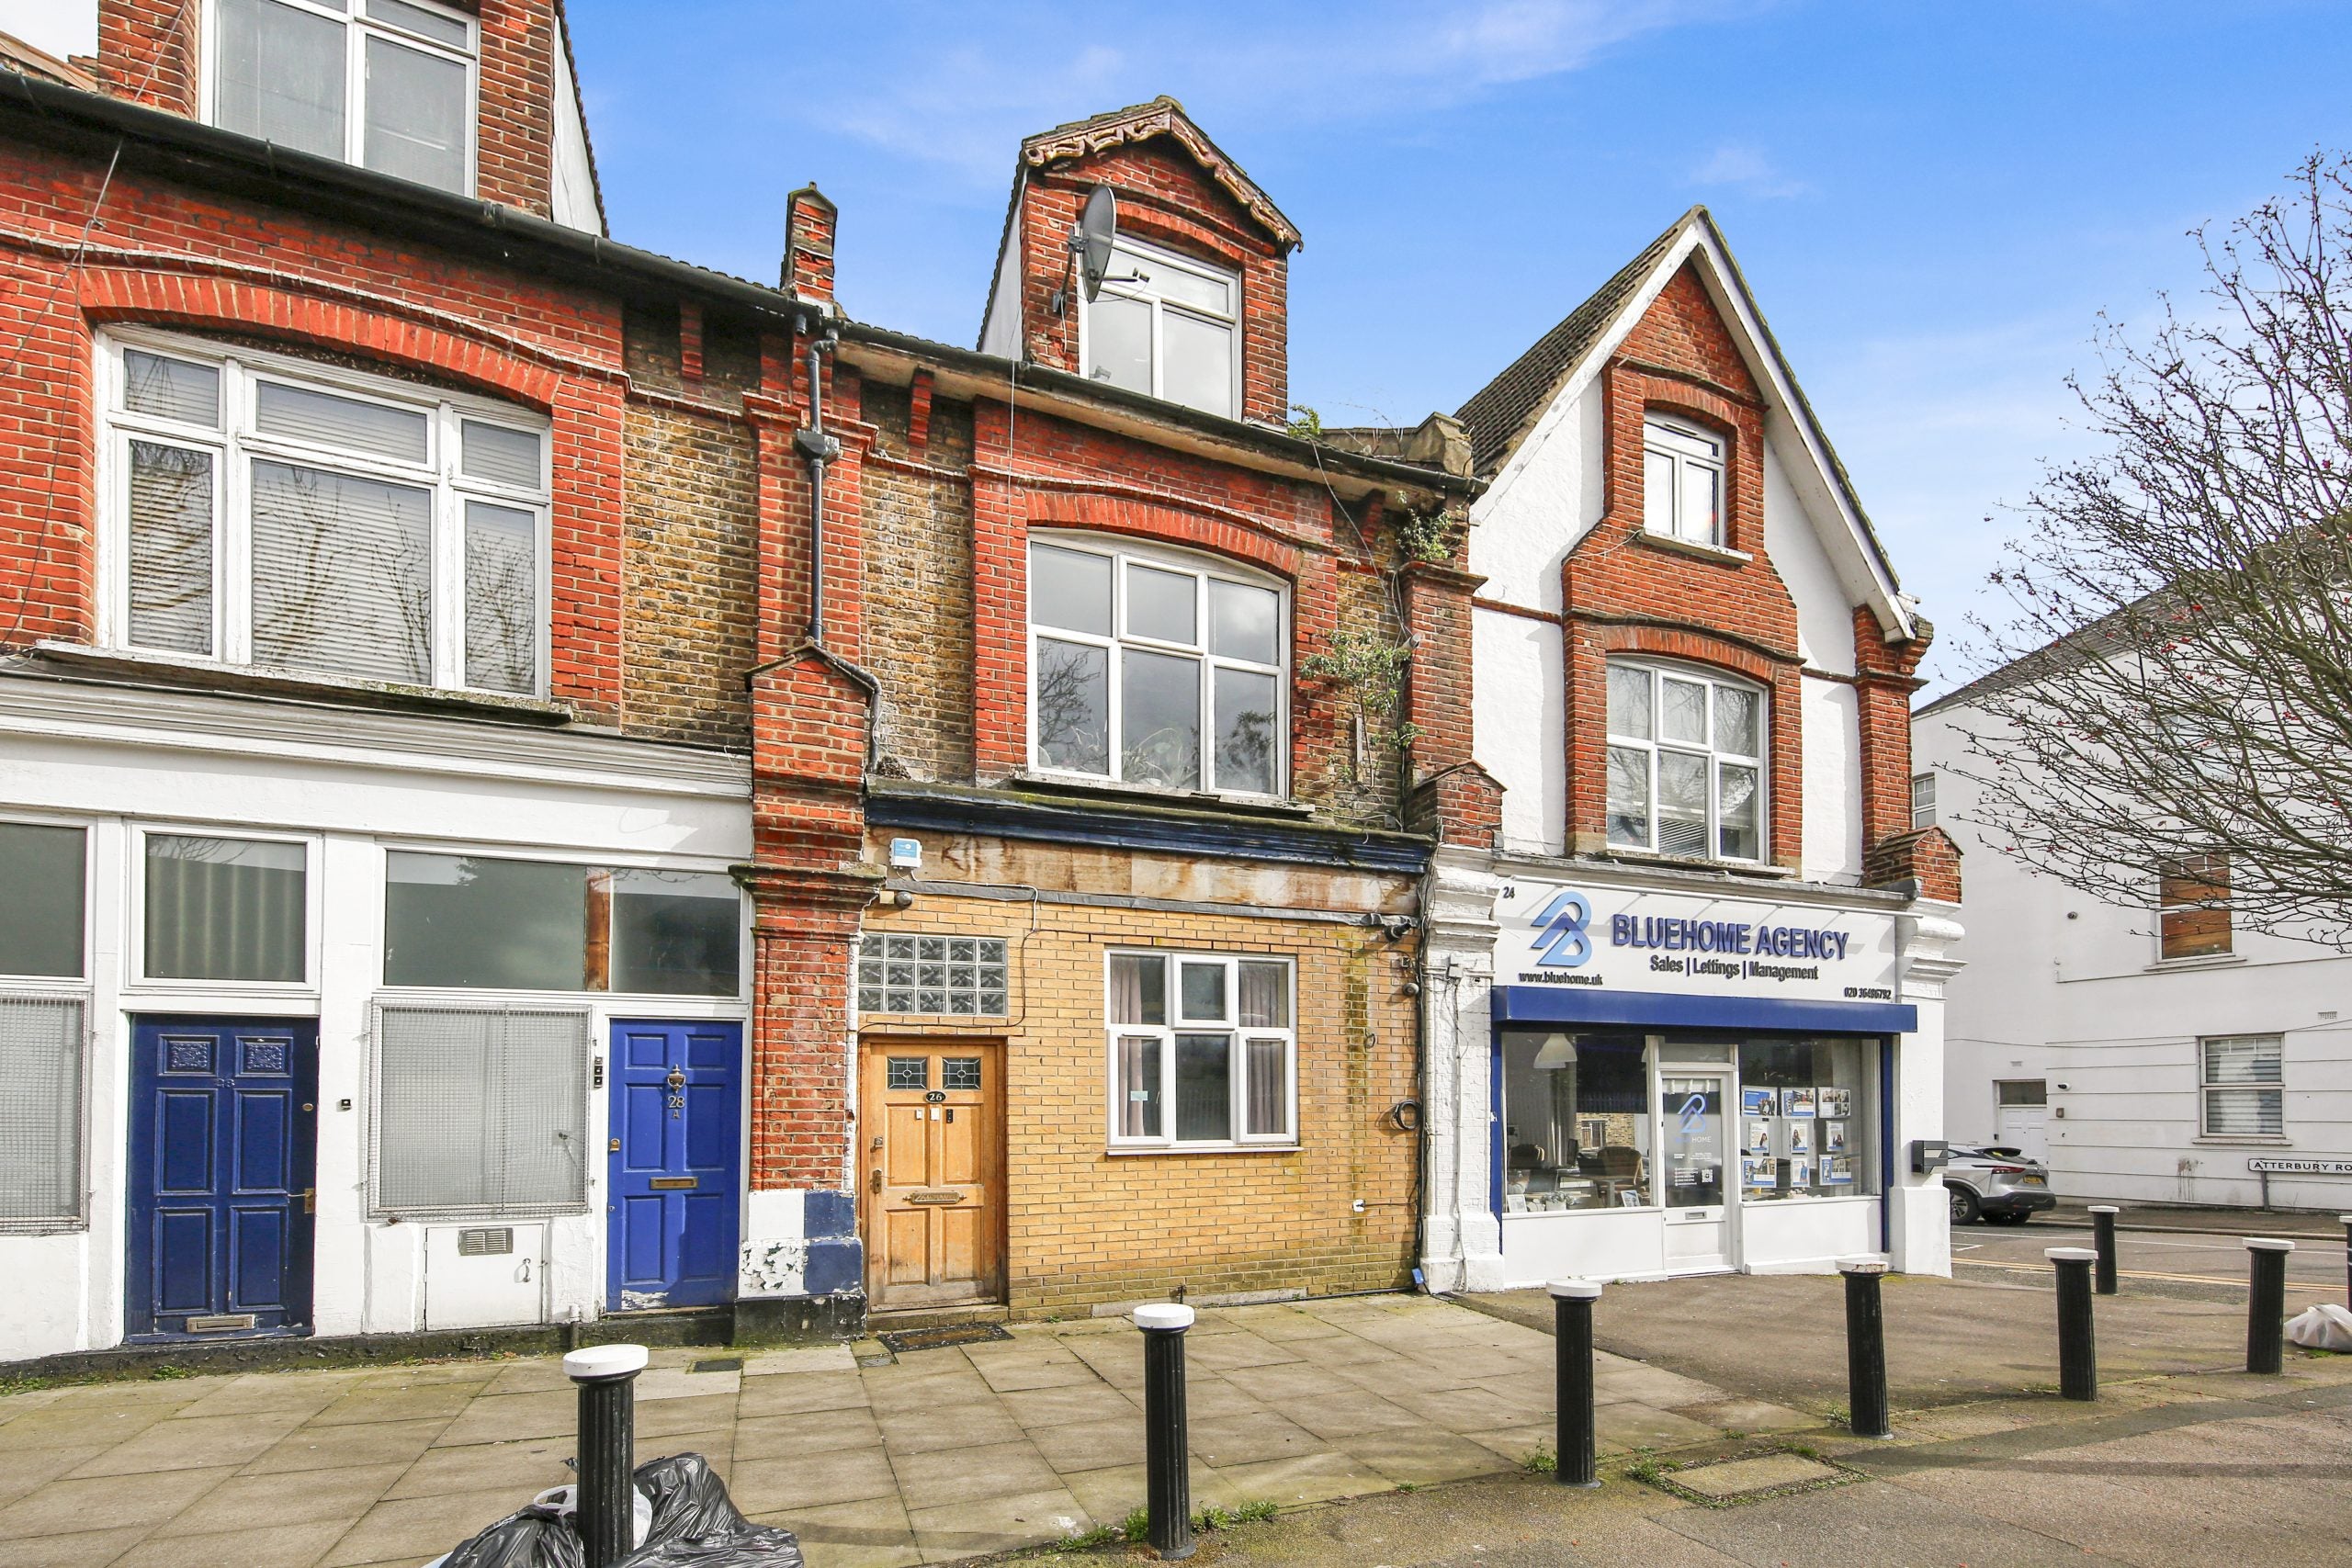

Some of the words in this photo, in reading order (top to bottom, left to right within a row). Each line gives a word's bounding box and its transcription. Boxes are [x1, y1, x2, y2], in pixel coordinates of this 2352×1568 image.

[1502, 886, 1515, 898] 24
[1612, 913, 1751, 954] BLUEHOME
[1756, 925, 1849, 960] AGENCY
[1650, 954, 1683, 973] Sales
[1692, 957, 1740, 978] Lettings
[1748, 960, 1819, 981] Management
[1519, 970, 1603, 986] www.bluehome.uk
[1844, 987, 1857, 998] 020
[668, 1095, 685, 1109] 28
[673, 1109, 680, 1119] A
[2254, 1161, 2329, 1171] ATTERBURY
